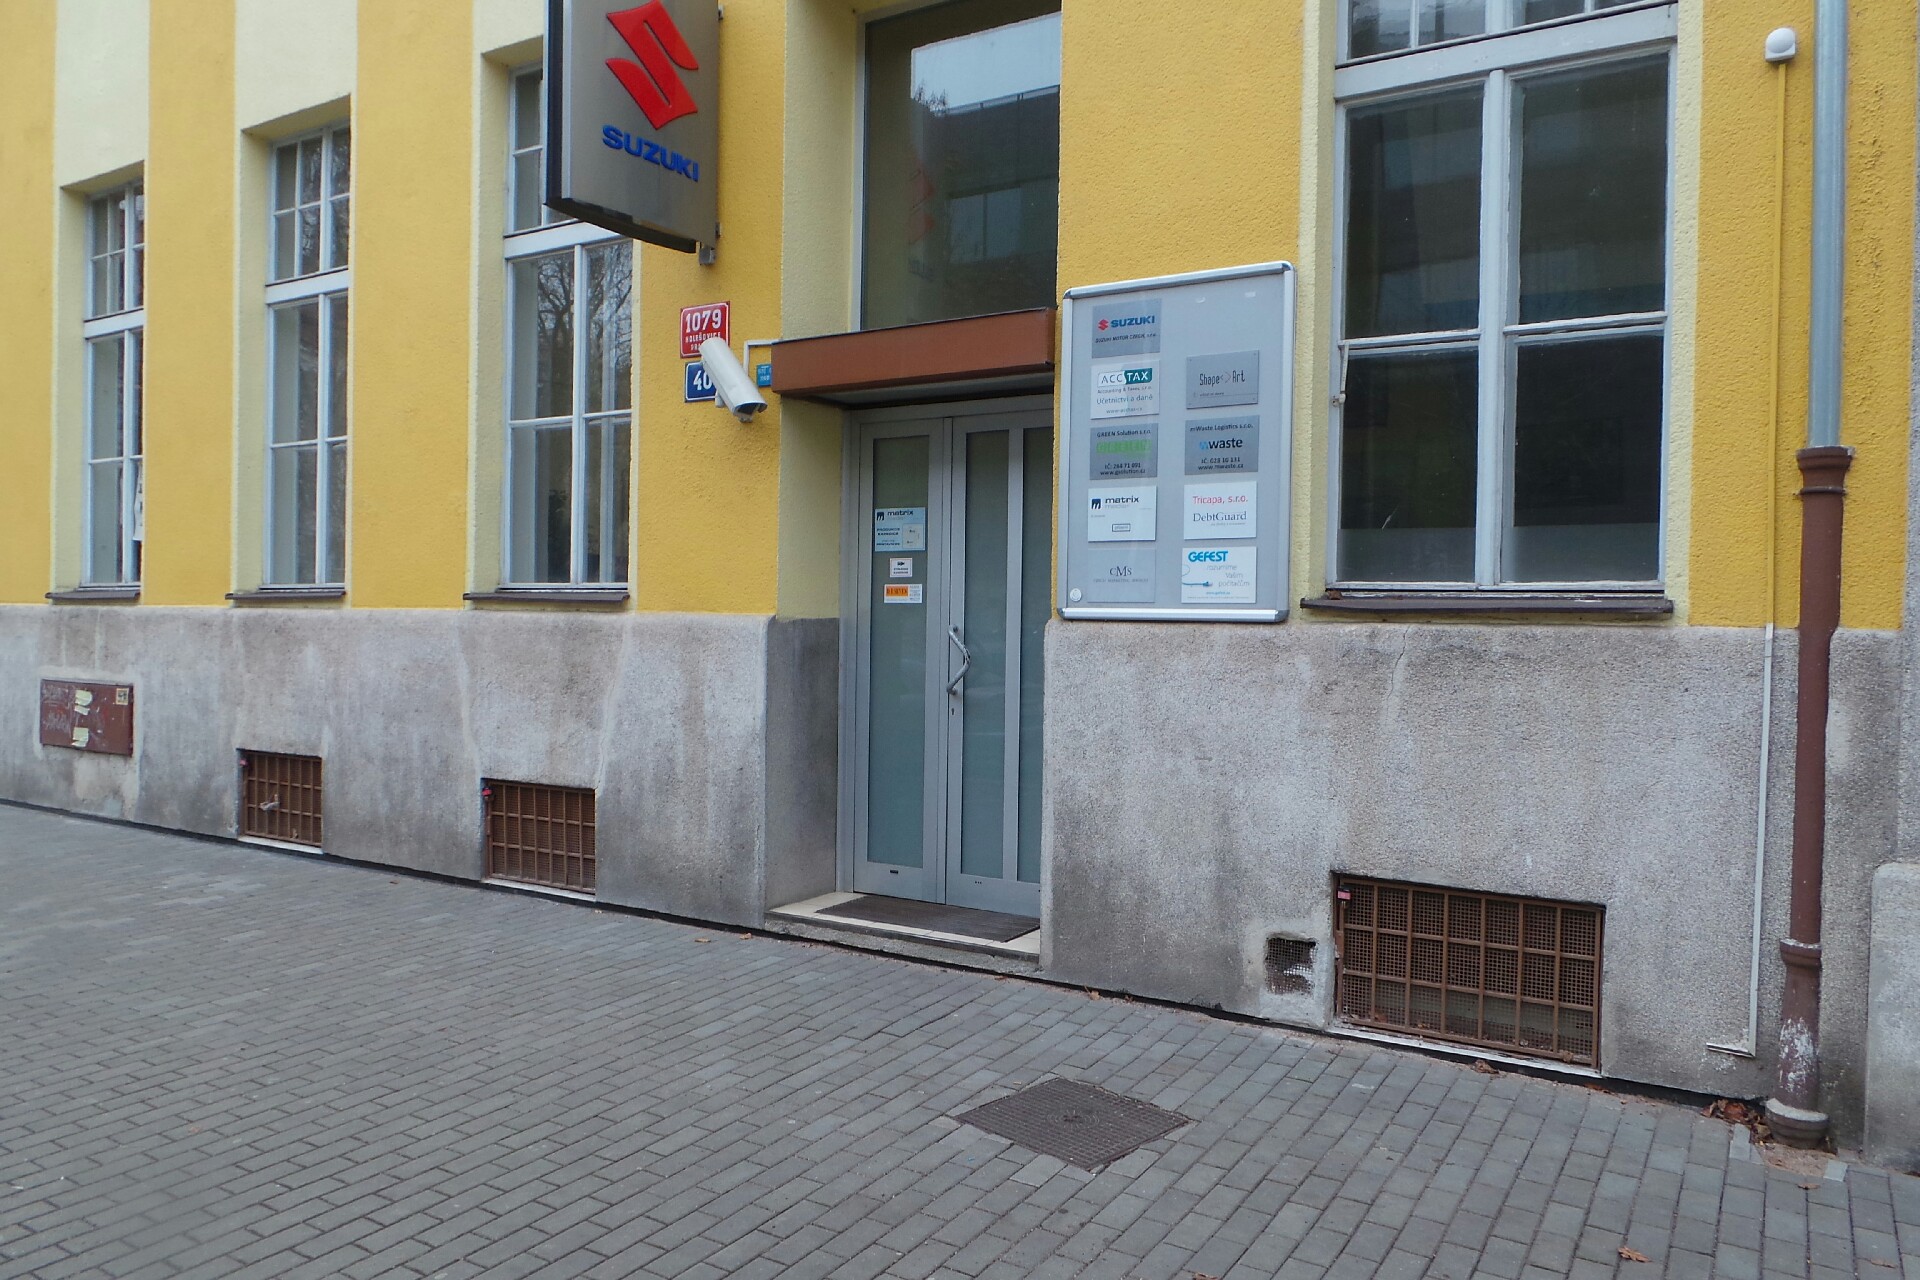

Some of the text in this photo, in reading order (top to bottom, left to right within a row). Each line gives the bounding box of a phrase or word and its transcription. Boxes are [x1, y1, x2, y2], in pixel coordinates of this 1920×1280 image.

[602, 124, 699, 183] SUZUKI
[685, 309, 722, 333] 1079
[1111, 315, 1155, 328] SUZUKI
[1105, 495, 1139, 504] matrix
[1192, 495, 1248, 505] Tricapa, s.r.o.
[1193, 511, 1247, 522] DebtGuard
[1188, 550, 1228, 562] GEFEST
